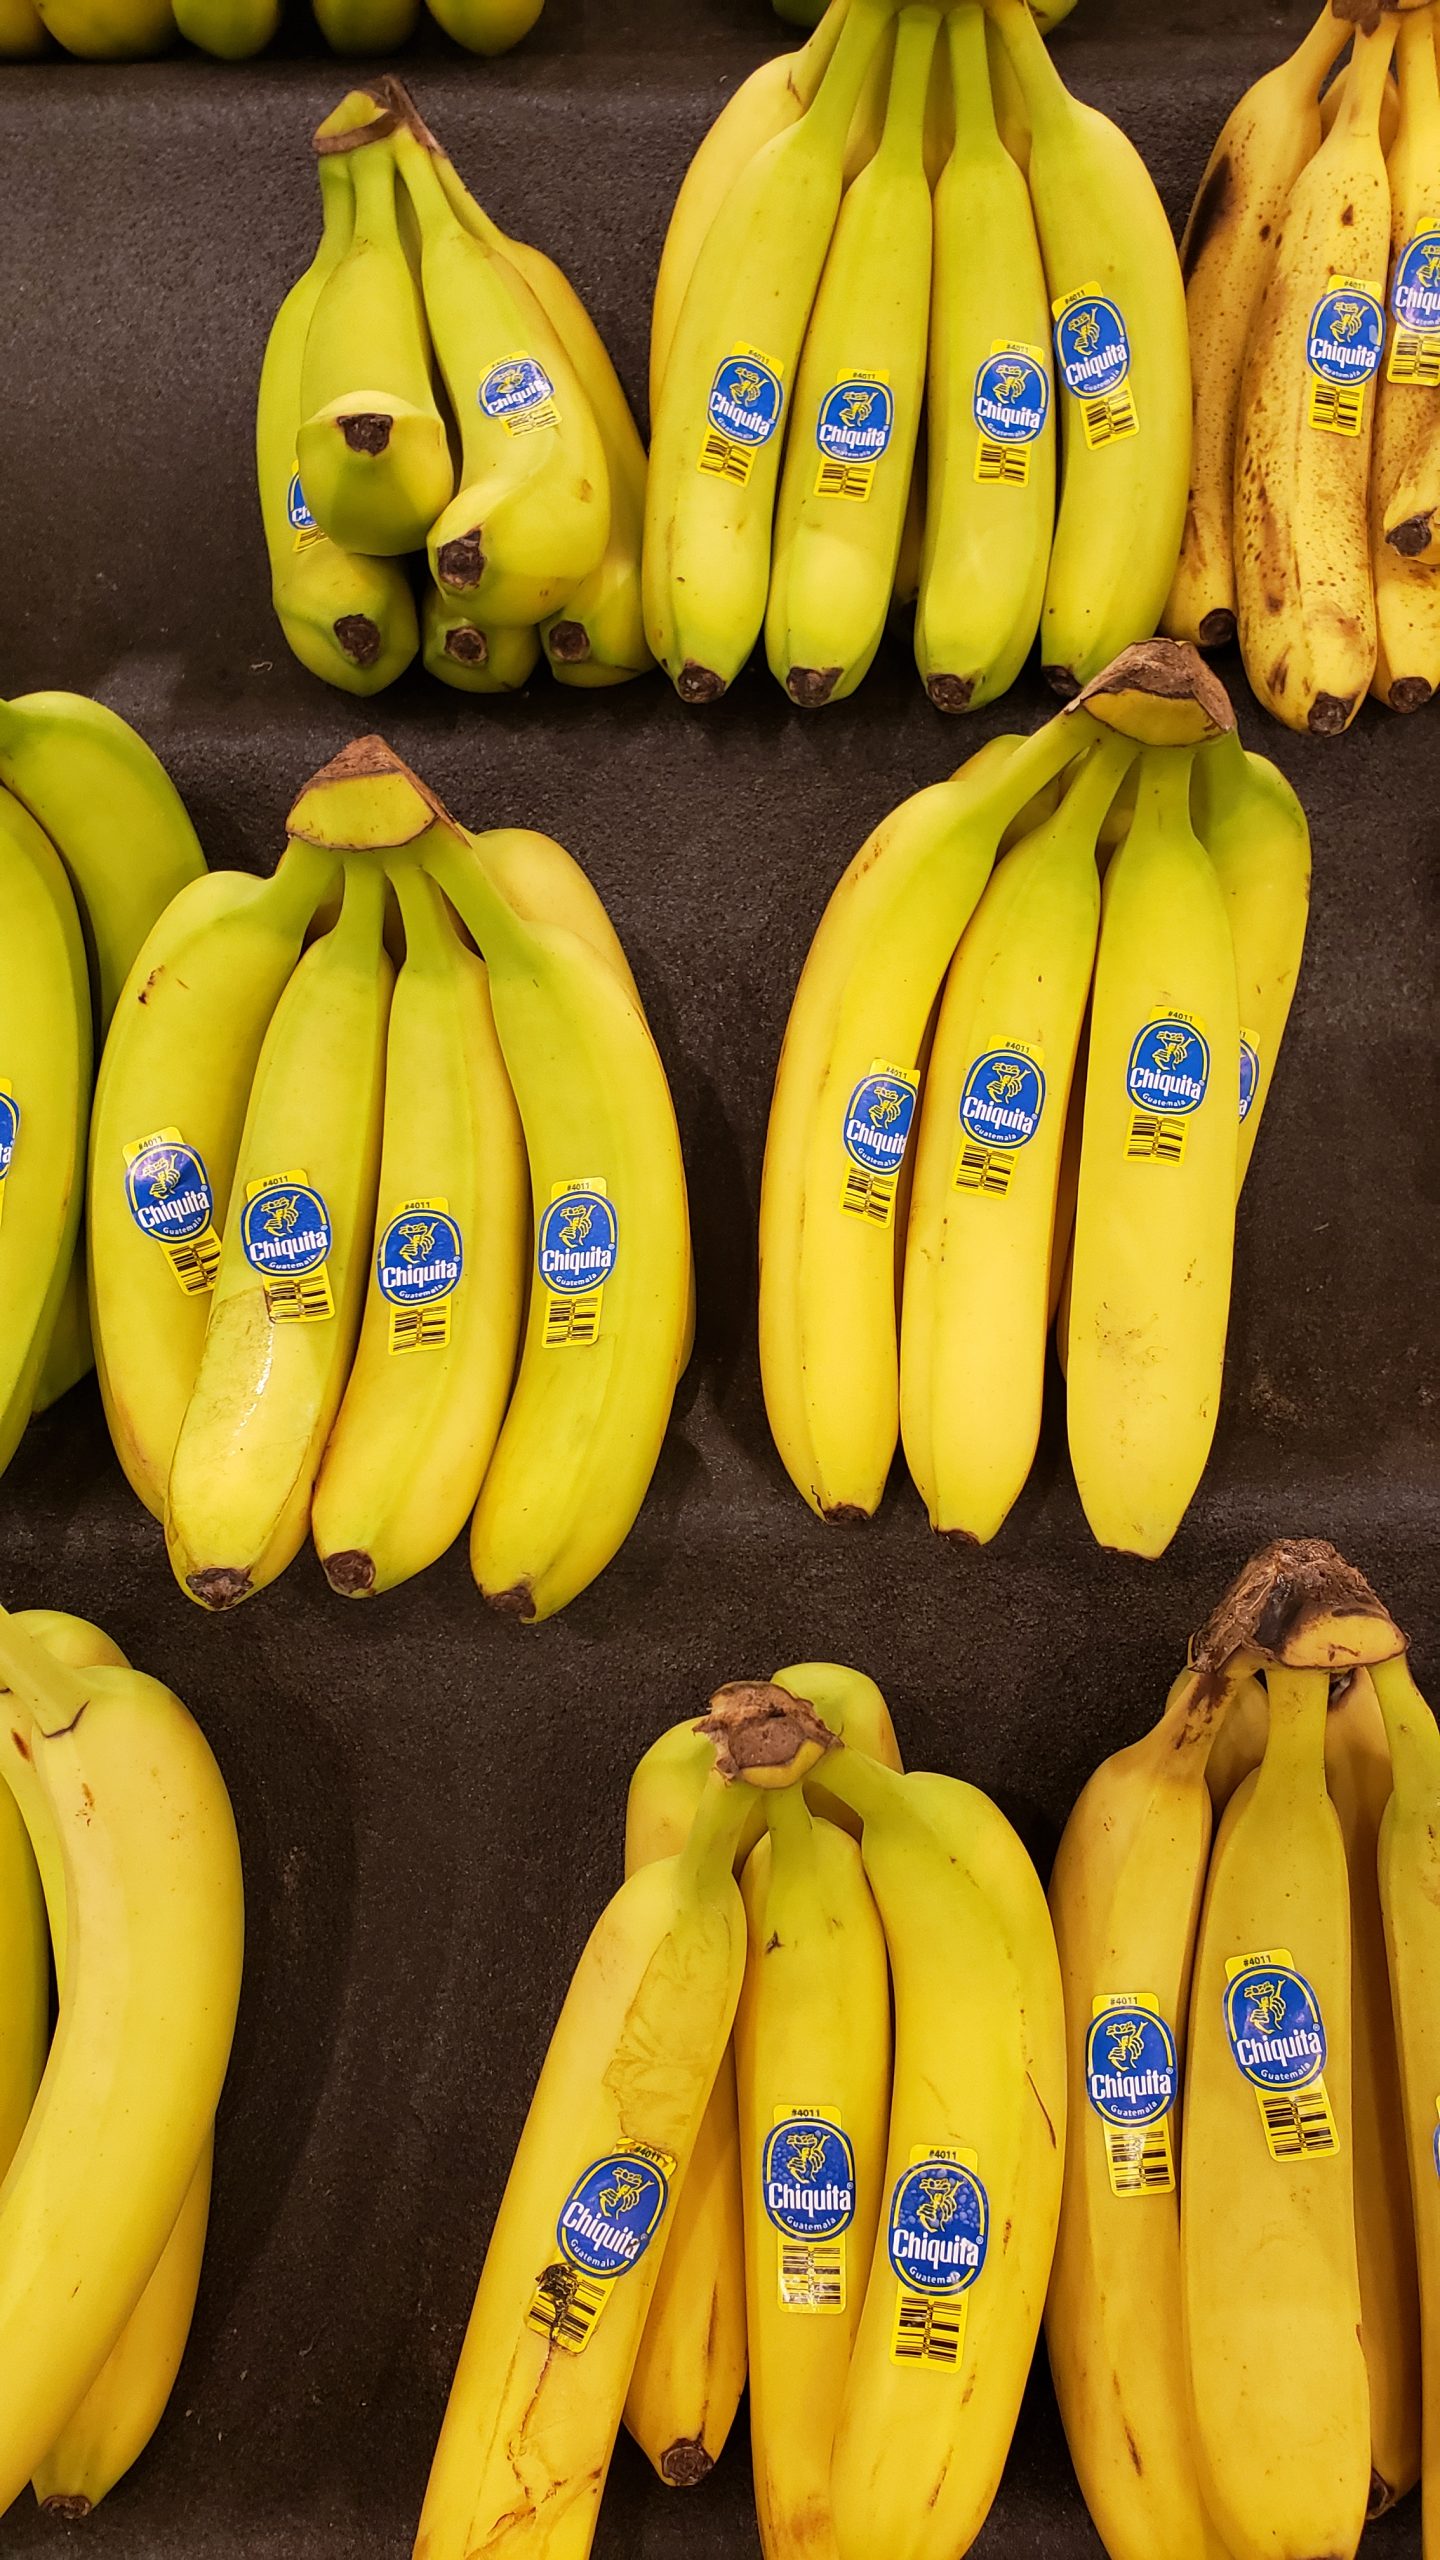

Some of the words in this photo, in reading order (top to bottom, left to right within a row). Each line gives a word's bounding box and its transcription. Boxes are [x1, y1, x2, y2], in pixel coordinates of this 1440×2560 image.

[1395, 285, 1440, 315] Chiqu
[1310, 338, 1377, 368] Chiquita
[1065, 343, 1127, 386] Chiquita
[709, 391, 769, 436] Chiquita
[976, 396, 1040, 429] Chiquita
[819, 424, 886, 449] Chiquita
[1168, 1011, 1193, 1023] #4011
[1005, 1042, 1030, 1054] #4011
[885, 1067, 907, 1079] #4011
[1130, 1067, 1201, 1100] Chiquita
[1142, 1093, 1186, 1108] Guatemala
[962, 1096, 1033, 1135] Chiquita
[974, 1124, 1017, 1141] Guatemala
[138, 1135, 164, 1152] #4011
[857, 1147, 896, 1167] Guatemala
[263, 1176, 289, 1189] #4011
[567, 1182, 590, 1191] #4011
[137, 1190, 209, 1229] Chiquita
[404, 1201, 430, 1210] #4011
[162, 1216, 203, 1236] Guatemala
[249, 1227, 328, 1262] Chiquita
[269, 1254, 316, 1270] Guatemala
[542, 1245, 612, 1275] Chiquita
[382, 1259, 457, 1288] Chiquita
[555, 1272, 598, 1286] Guatemala
[399, 1284, 443, 1299] Guatemala
[1243, 1955, 1271, 1967] #4011
[1109, 1996, 1138, 2006] #4011
[1236, 2029, 1322, 2067] Chiquita
[1260, 2062, 1311, 2081] Guatemala
[1091, 2068, 1172, 2104] Chiquita
[791, 2108, 820, 2118] #4011
[1110, 2101, 1158, 2117] Guatemala
[928, 2149, 957, 2161] #4011
[768, 2182, 851, 2219] Chiquita
[562, 2200, 641, 2261] Chiquita
[786, 2216, 836, 2231] Guatemala
[569, 2239, 616, 2269] Guatemala
[892, 2229, 979, 2270] Chiquita
